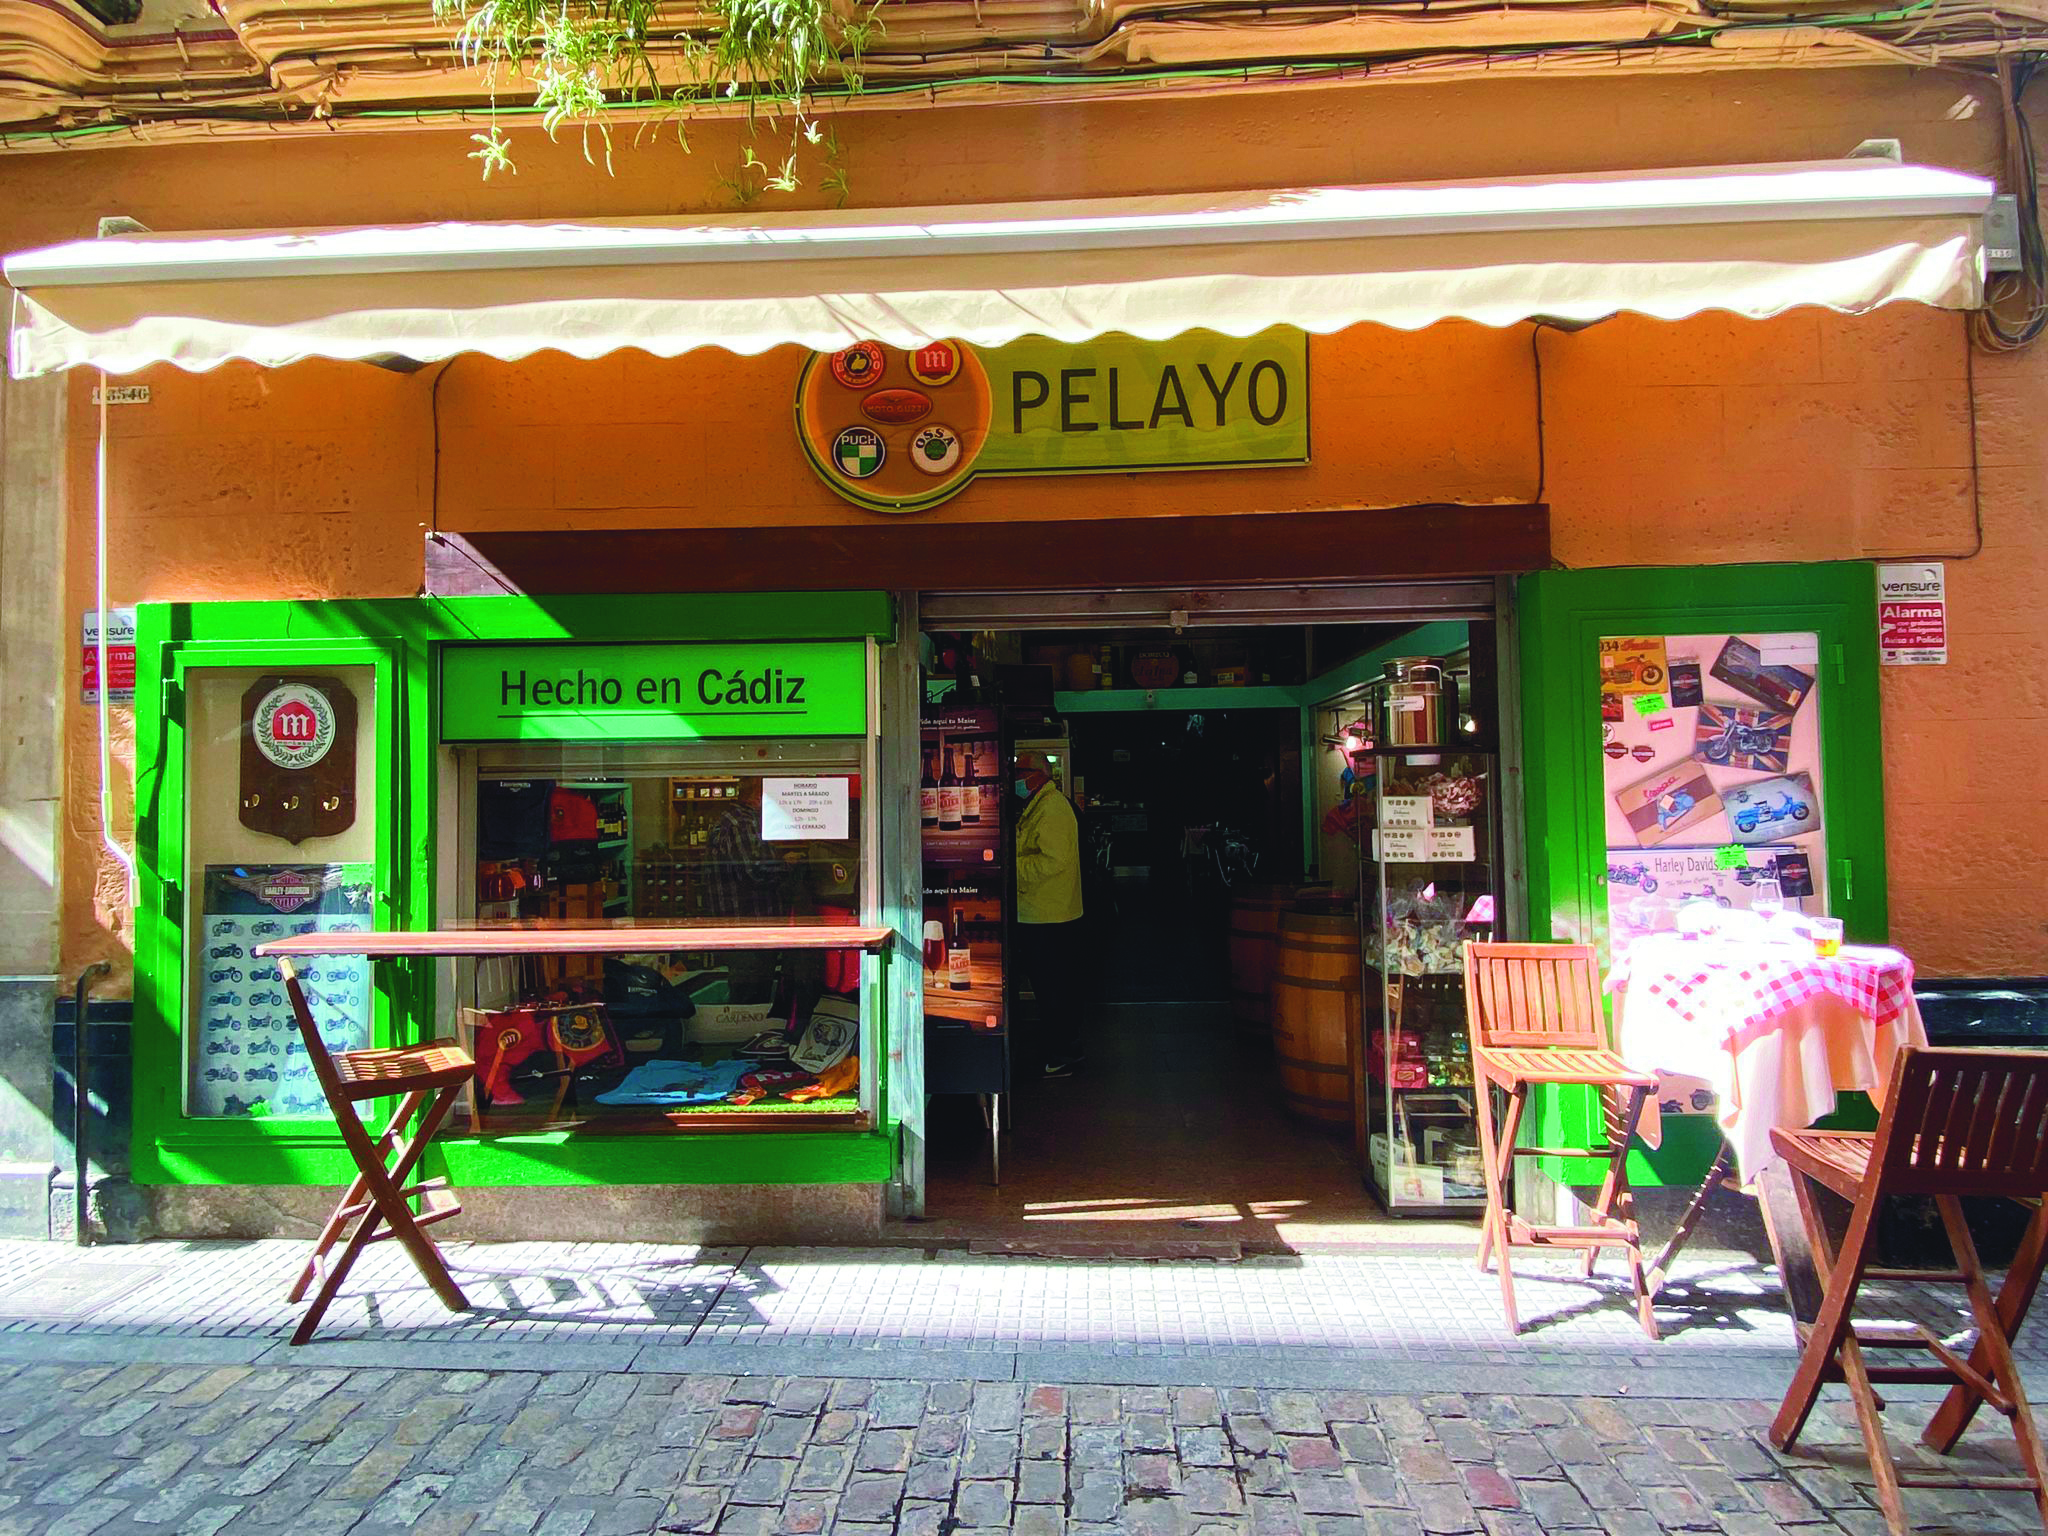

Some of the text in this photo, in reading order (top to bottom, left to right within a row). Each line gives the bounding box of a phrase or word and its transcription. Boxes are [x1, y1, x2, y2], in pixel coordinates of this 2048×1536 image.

[1011, 359, 1288, 434] PELAYO
[867, 405, 925, 413] MOTO GUZZI
[841, 435, 877, 445] PUCH
[915, 428, 955, 449] OSSA
[1881, 582, 1941, 592] verisure
[1882, 605, 1942, 618] Alarma
[84, 626, 135, 636] veisure
[84, 650, 135, 661] Arma
[501, 668, 806, 706] Hecho en Cádiz
[1655, 857, 1685, 875] Harley
[1687, 856, 1730, 871] Davids
